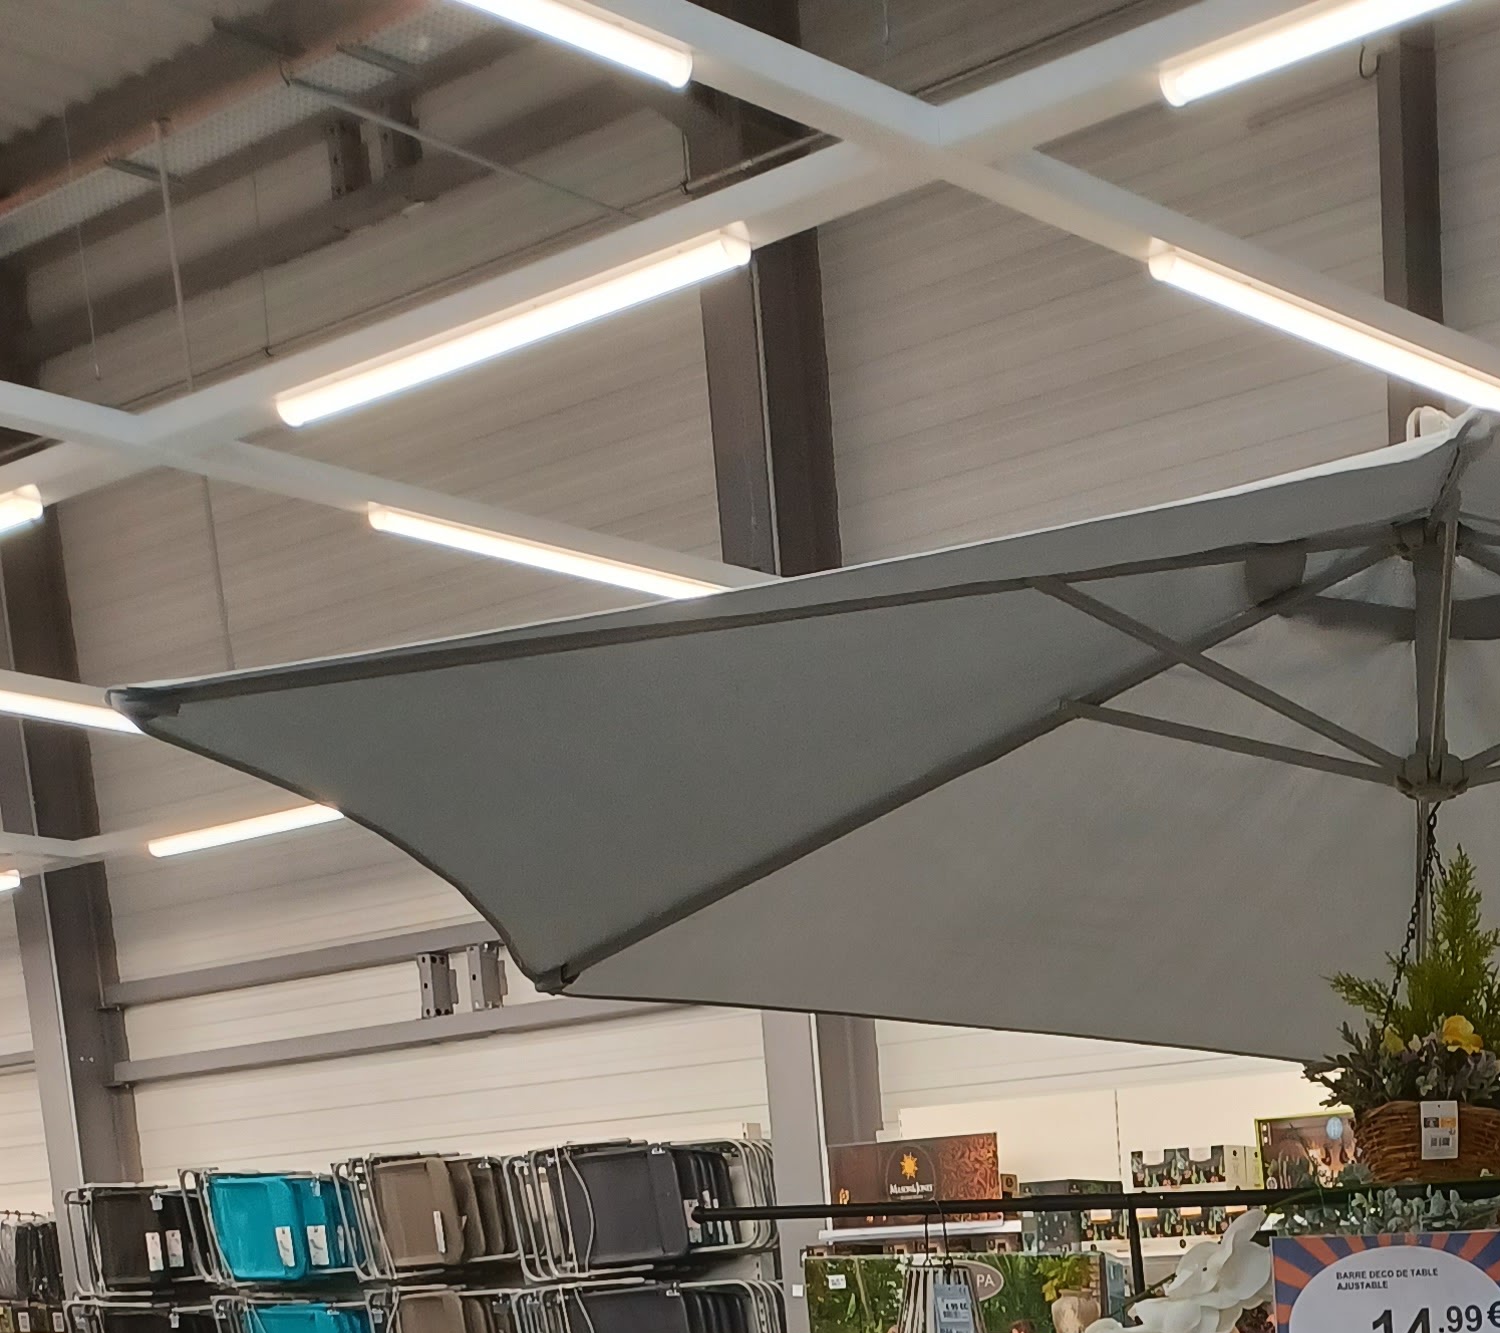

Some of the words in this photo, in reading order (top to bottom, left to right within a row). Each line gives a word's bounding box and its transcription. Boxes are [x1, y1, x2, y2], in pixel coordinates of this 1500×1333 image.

[1336, 1270, 1367, 1280] BARRE
[1369, 1270, 1393, 1279] DECO
[1396, 1269, 1408, 1278] DE
[1410, 1268, 1439, 1277] TABLE
[1336, 1281, 1388, 1290] AJUSTABLE
